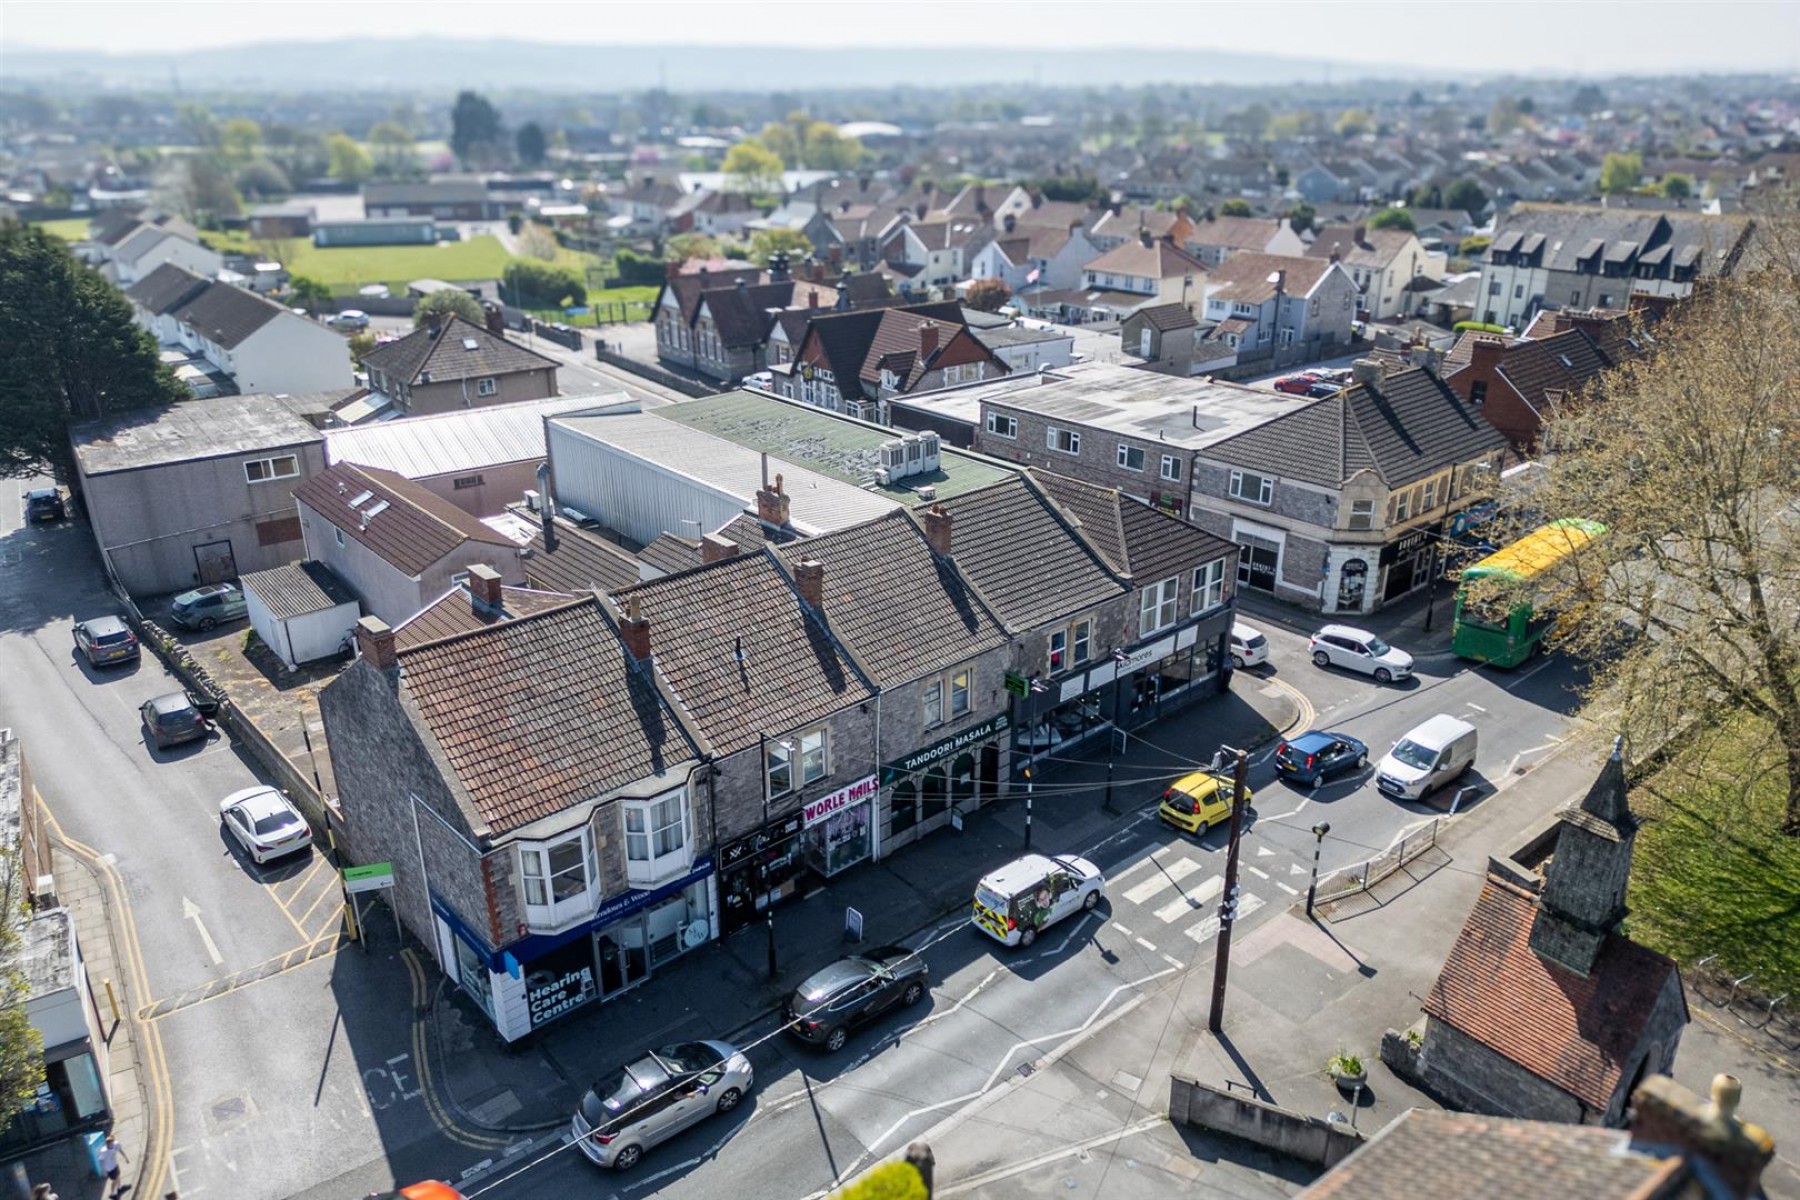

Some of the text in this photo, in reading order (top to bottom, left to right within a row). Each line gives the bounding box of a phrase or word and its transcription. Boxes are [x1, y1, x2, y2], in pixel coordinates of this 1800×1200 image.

[905, 725, 991, 770] TANDOORI MASALA
[805, 778, 879, 820] WORLE NAILS
[530, 968, 590, 1002] Hearing
[531, 990, 567, 1013] Care
[533, 993, 585, 1024] Centre
